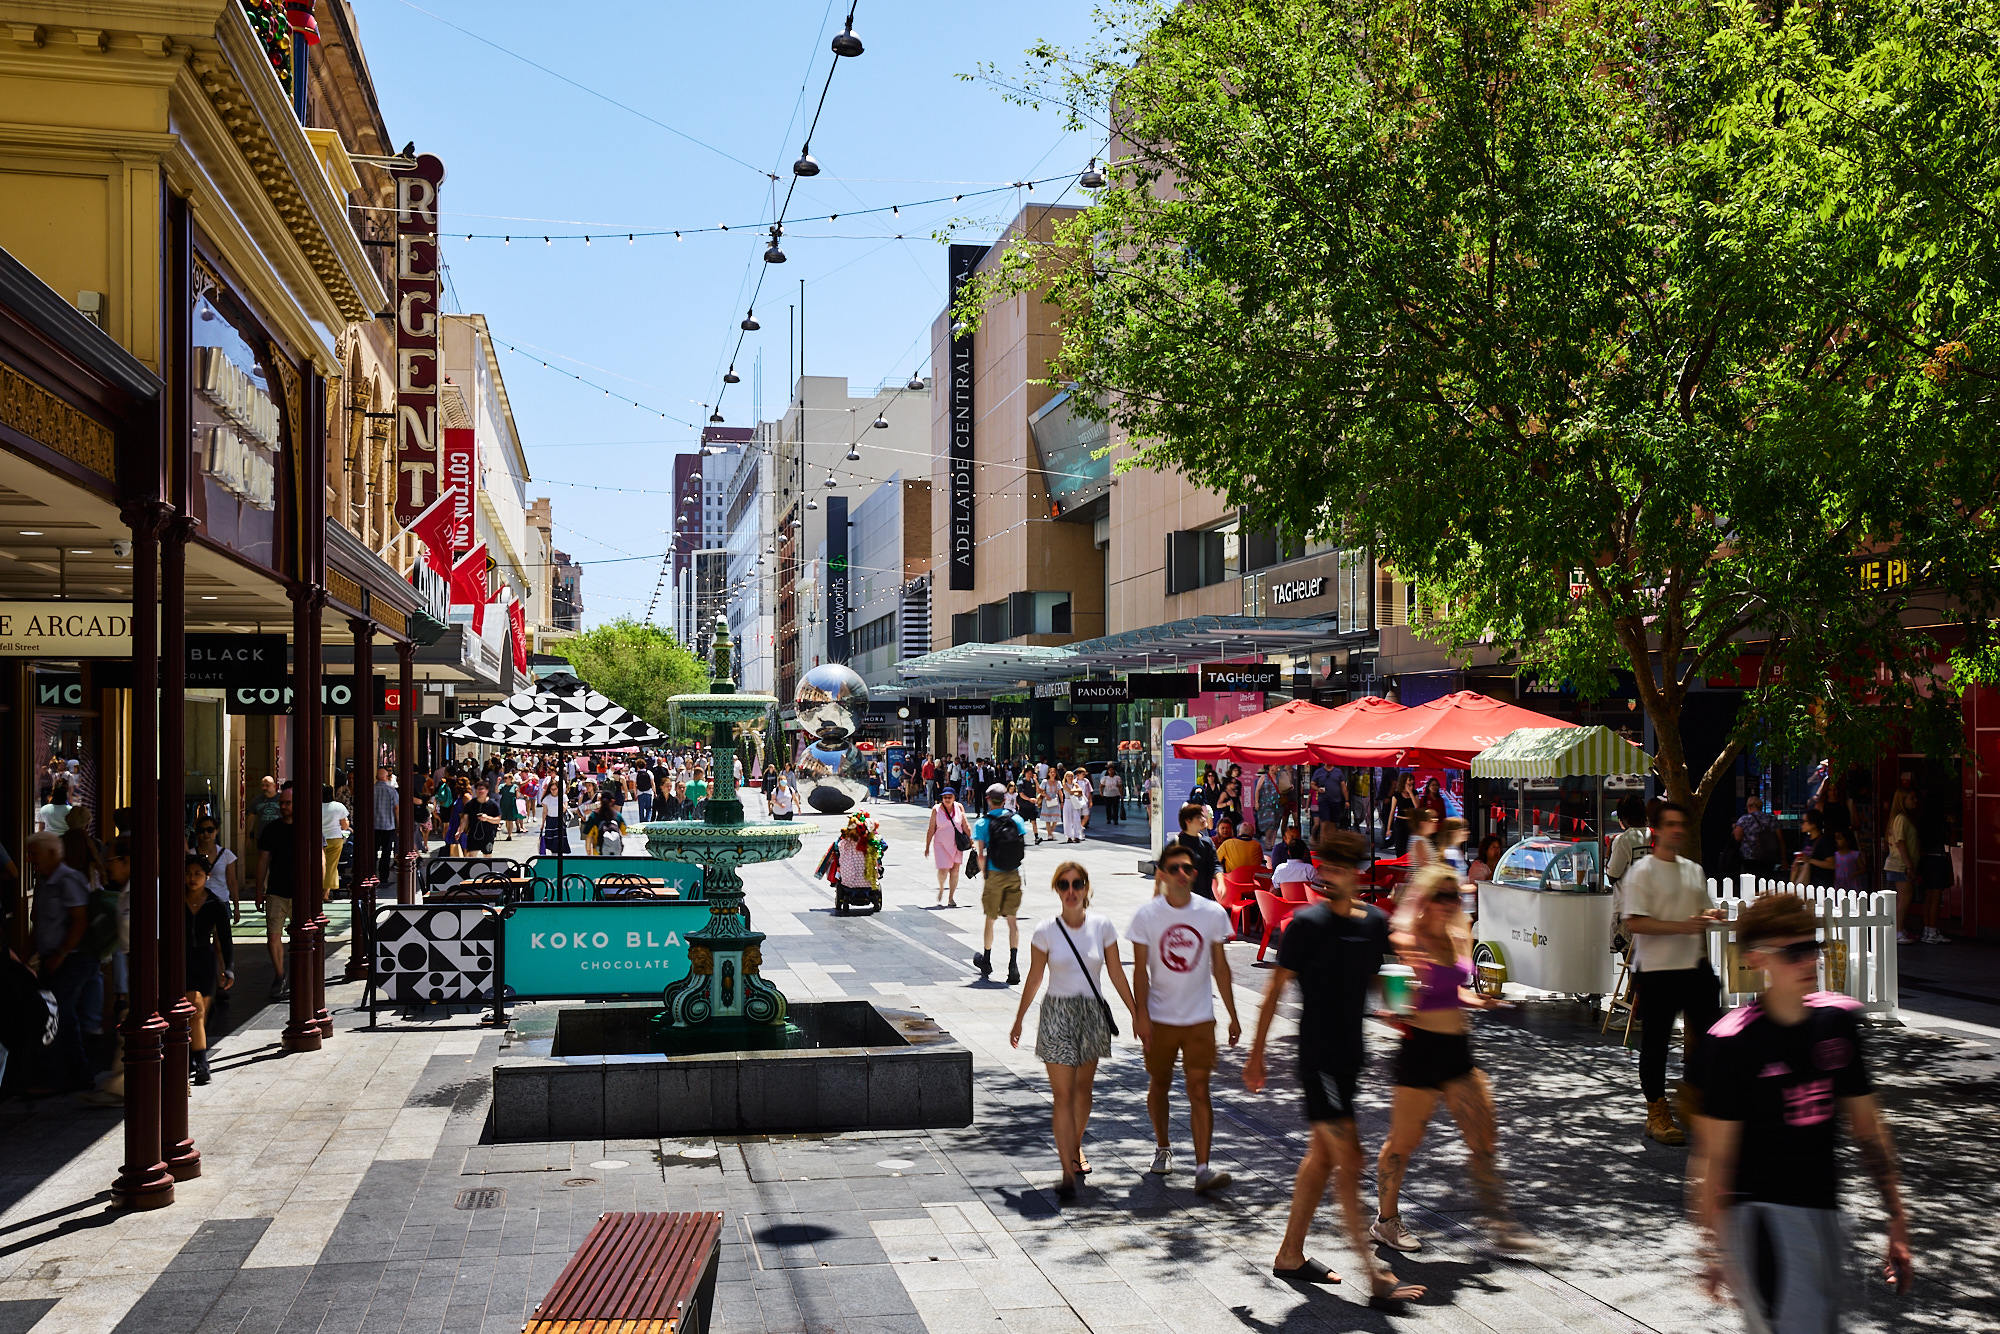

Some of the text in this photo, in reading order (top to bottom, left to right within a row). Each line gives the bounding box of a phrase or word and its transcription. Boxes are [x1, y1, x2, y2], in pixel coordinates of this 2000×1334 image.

[397, 177, 437, 507] REGENT
[956, 348, 970, 448] CENTRAL
[450, 452, 469, 520] COTTON
[956, 458, 970, 565] ADELAIDE
[454, 523, 469, 547] ON
[834, 577, 845, 637] Woolworths
[15, 642, 40, 651] Street
[191, 648, 265, 661] BLACK
[531, 931, 695, 950] KOKO BLA
[580, 960, 670, 971] CHOCOLATE
